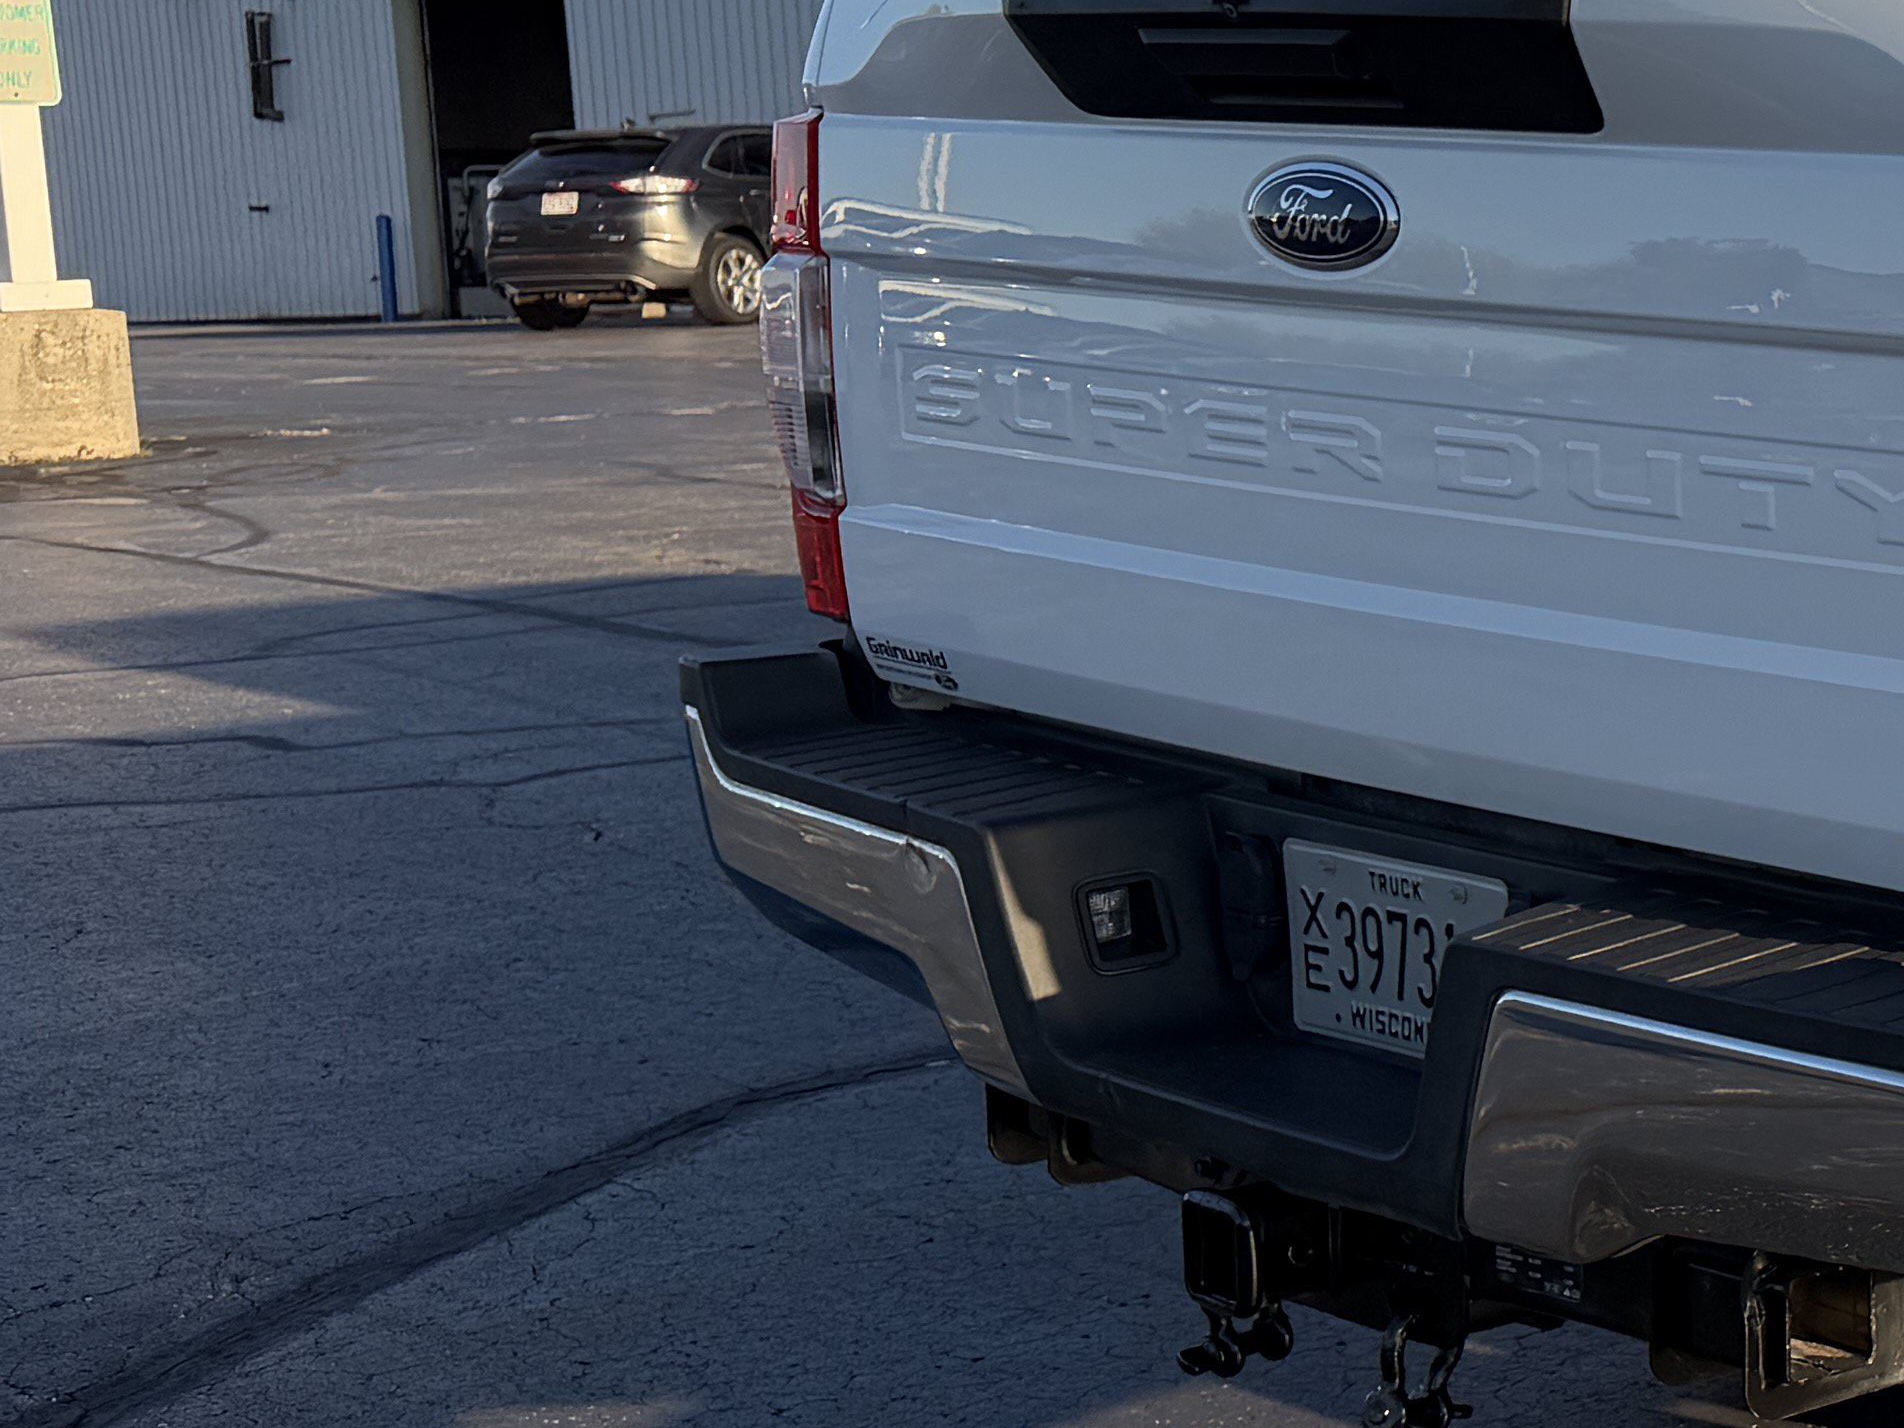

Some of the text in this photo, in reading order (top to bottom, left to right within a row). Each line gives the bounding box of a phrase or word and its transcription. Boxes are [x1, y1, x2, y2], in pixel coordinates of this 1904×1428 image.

[1273, 184, 1352, 244] Ford
[912, 364, 1383, 484] SUPER
[1368, 870, 1425, 902] TRUCK
[1335, 900, 1455, 1010] 3973
[1351, 1005, 1425, 1044] WISCON
